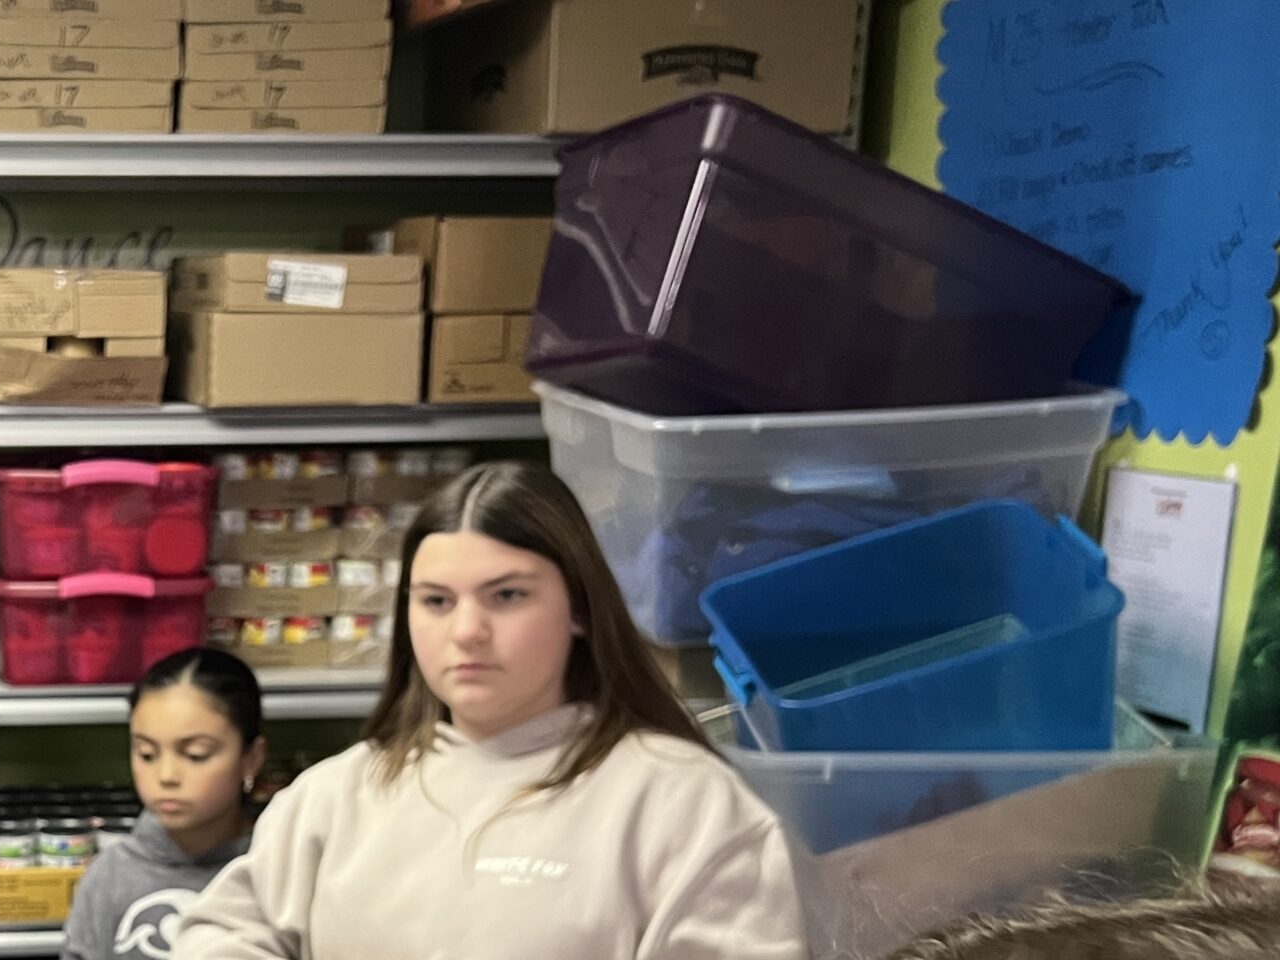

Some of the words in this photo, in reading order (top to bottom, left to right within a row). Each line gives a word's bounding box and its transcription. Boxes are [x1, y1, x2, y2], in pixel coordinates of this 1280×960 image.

[59, 24, 92, 47] 17
[54, 83, 80, 107] 17
[264, 80, 297, 108] 17
